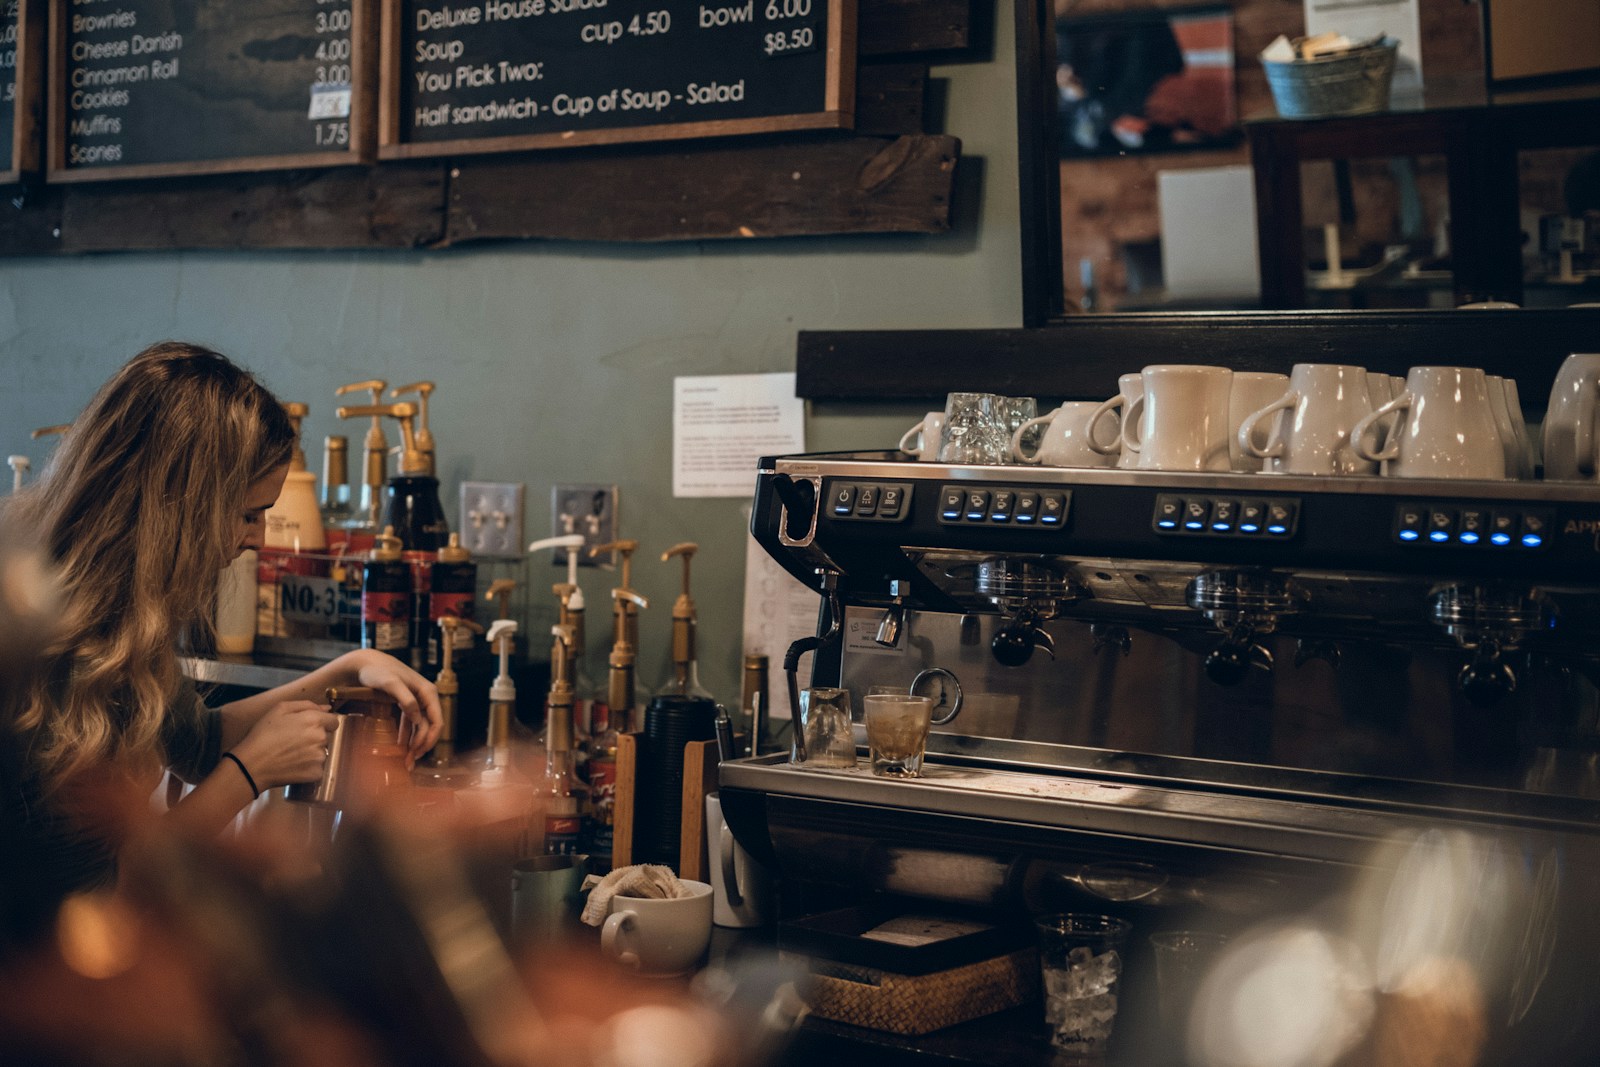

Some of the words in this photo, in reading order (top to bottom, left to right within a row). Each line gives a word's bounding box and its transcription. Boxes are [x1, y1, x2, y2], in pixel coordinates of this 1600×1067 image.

[72, 40, 129, 61] Cheese
[131, 31, 182, 55] Danish
[315, 9, 351, 33] 3.00
[73, 8, 136, 33] Brownies
[415, 40, 464, 62] Soup
[581, 21, 623, 44] cup
[627, 10, 671, 36] 4.50
[699, 1, 753, 28] bowl
[765, 0, 811, 20] 6.00
[416, 6, 481, 32] Deluxe
[485, 0, 545, 22] House
[72, 65, 149, 88] Cinnamon
[151, 58, 179, 80] Roll
[315, 38, 350, 60] 4.00
[415, 71, 452, 93] You
[455, 63, 496, 88] Pick
[498, 61, 544, 83] Two:
[764, 27, 813, 55] $8.50
[71, 87, 130, 110] Cookies
[315, 64, 350, 88] 3.00
[415, 103, 450, 127] Half
[452, 97, 538, 124] sandwich
[552, 93, 594, 118] Cup
[597, 89, 619, 112] of
[621, 88, 671, 112] Soup
[686, 79, 745, 105] Salad
[70, 144, 122, 163] Scones
[315, 122, 349, 146] 1.75
[71, 114, 122, 136] Muffins
